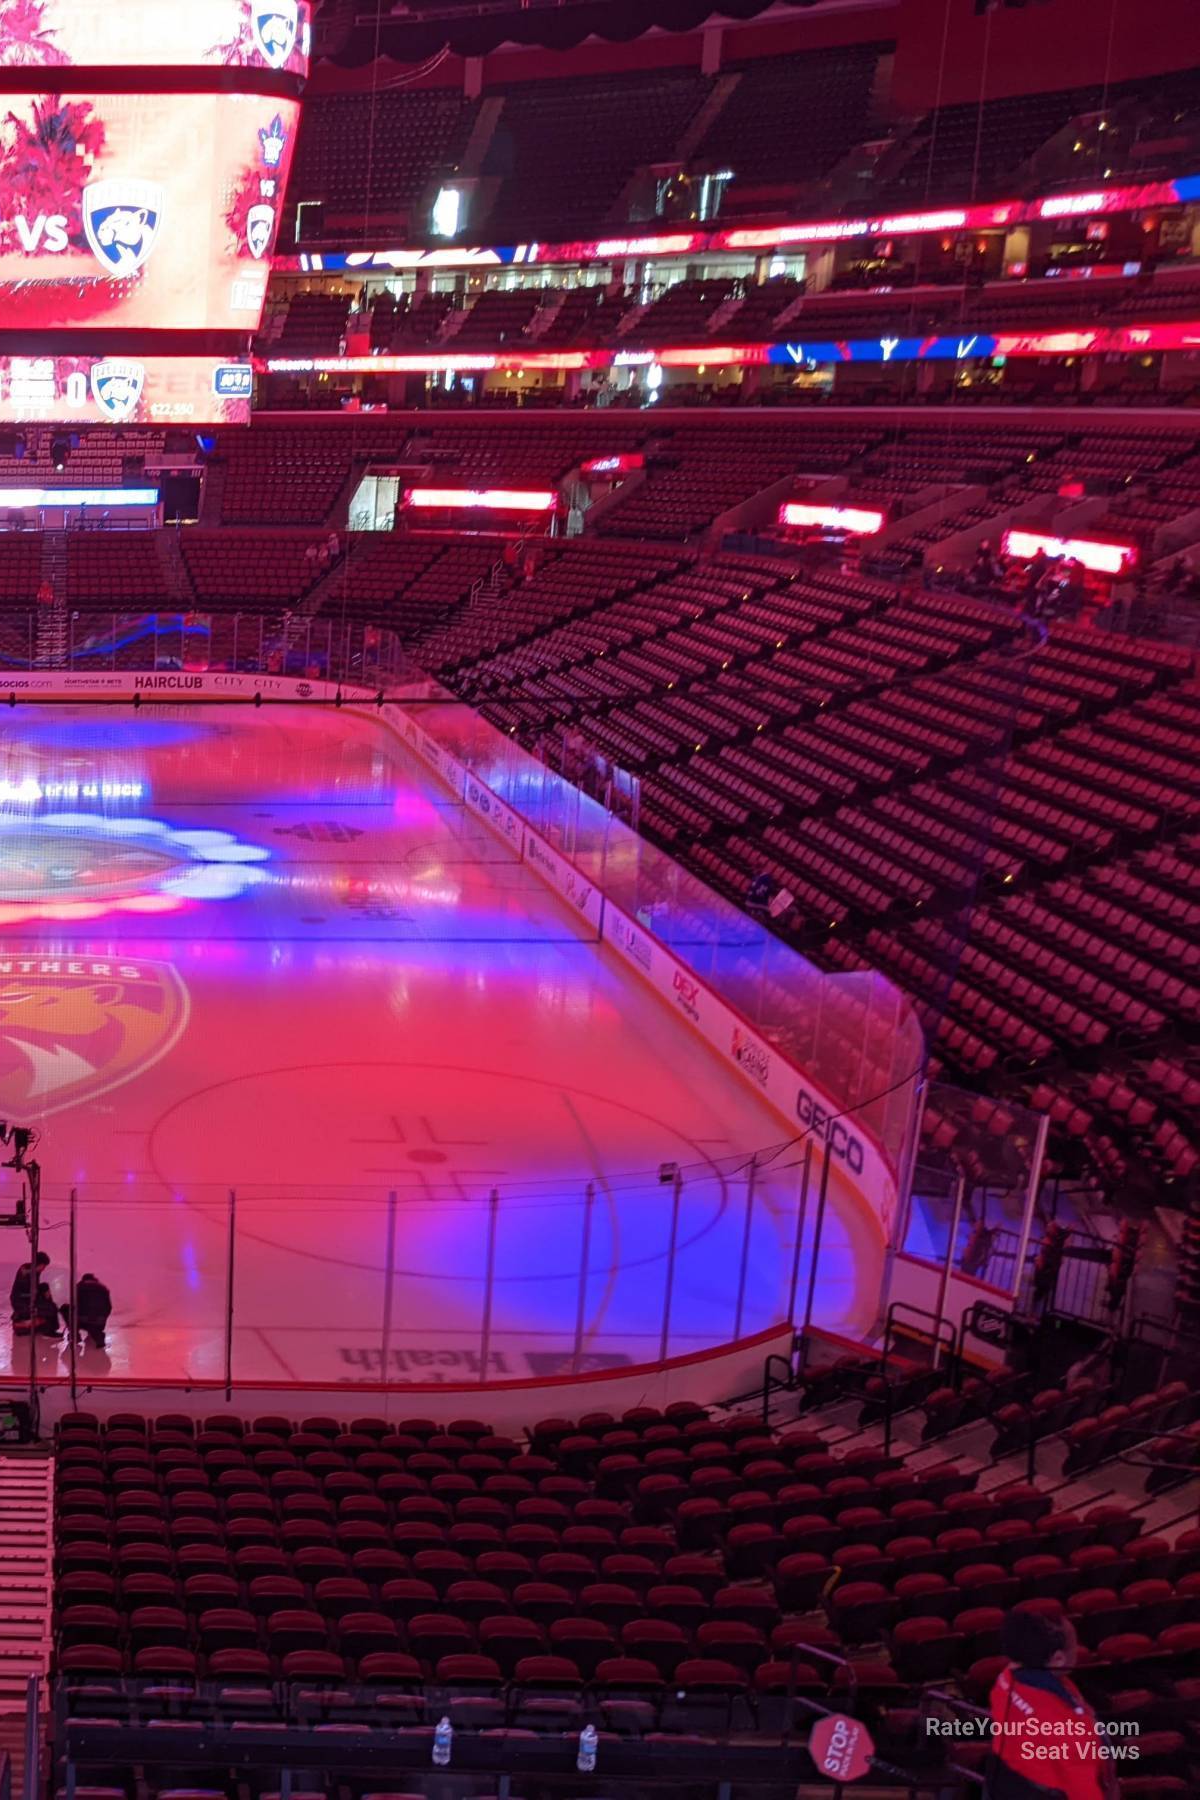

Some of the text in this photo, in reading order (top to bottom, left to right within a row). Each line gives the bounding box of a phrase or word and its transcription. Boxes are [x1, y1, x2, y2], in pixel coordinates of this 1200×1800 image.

[15, 214, 68, 252] VS
[67, 373, 86, 408] 0
[135, 676, 203, 689] HAIRCLUB
[673, 971, 699, 1006] DEX
[797, 1089, 864, 1175] GEICO
[337, 1348, 513, 1374] Health
[824, 1720, 852, 1772] STOP
